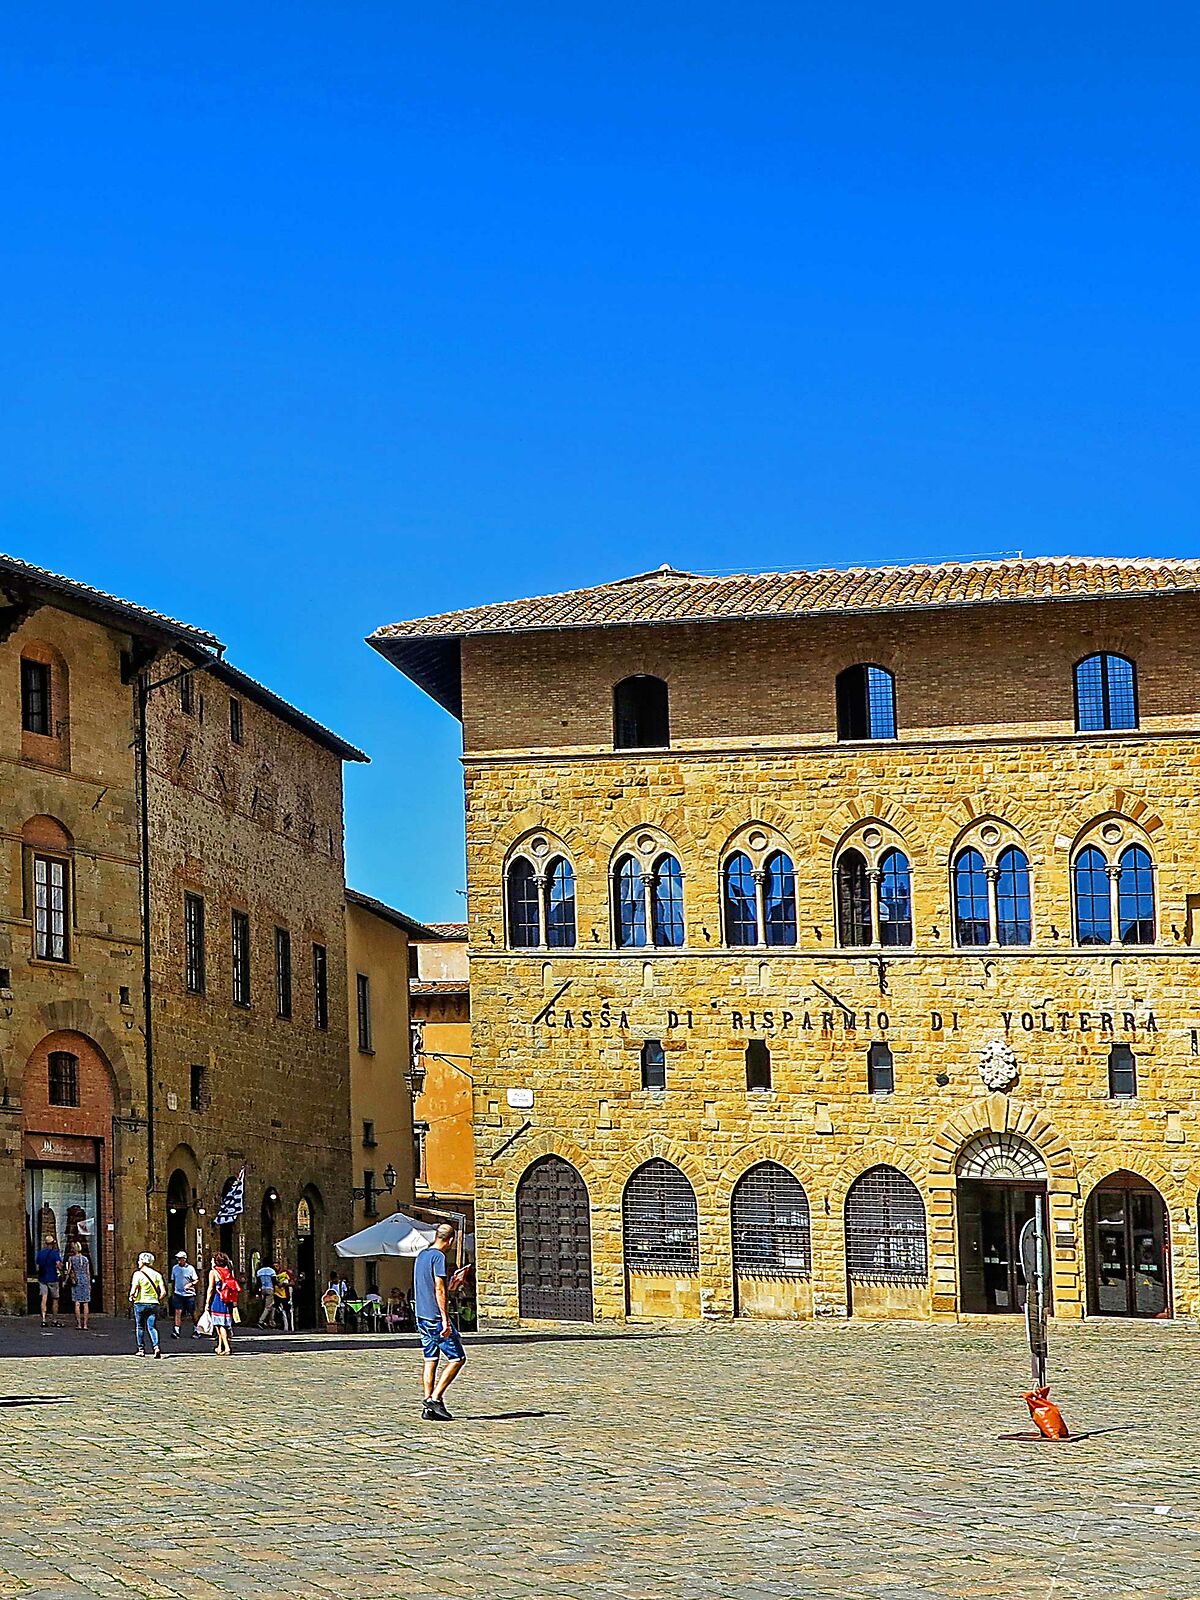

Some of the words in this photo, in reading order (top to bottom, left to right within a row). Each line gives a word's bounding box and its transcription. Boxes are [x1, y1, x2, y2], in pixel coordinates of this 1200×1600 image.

[544, 1009, 630, 1029] CASSA
[667, 1010, 694, 1029] DI
[731, 1010, 890, 1031] RISPARMIO
[930, 1011, 960, 1032] DI
[1001, 1011, 1159, 1032] VOLTERRA
